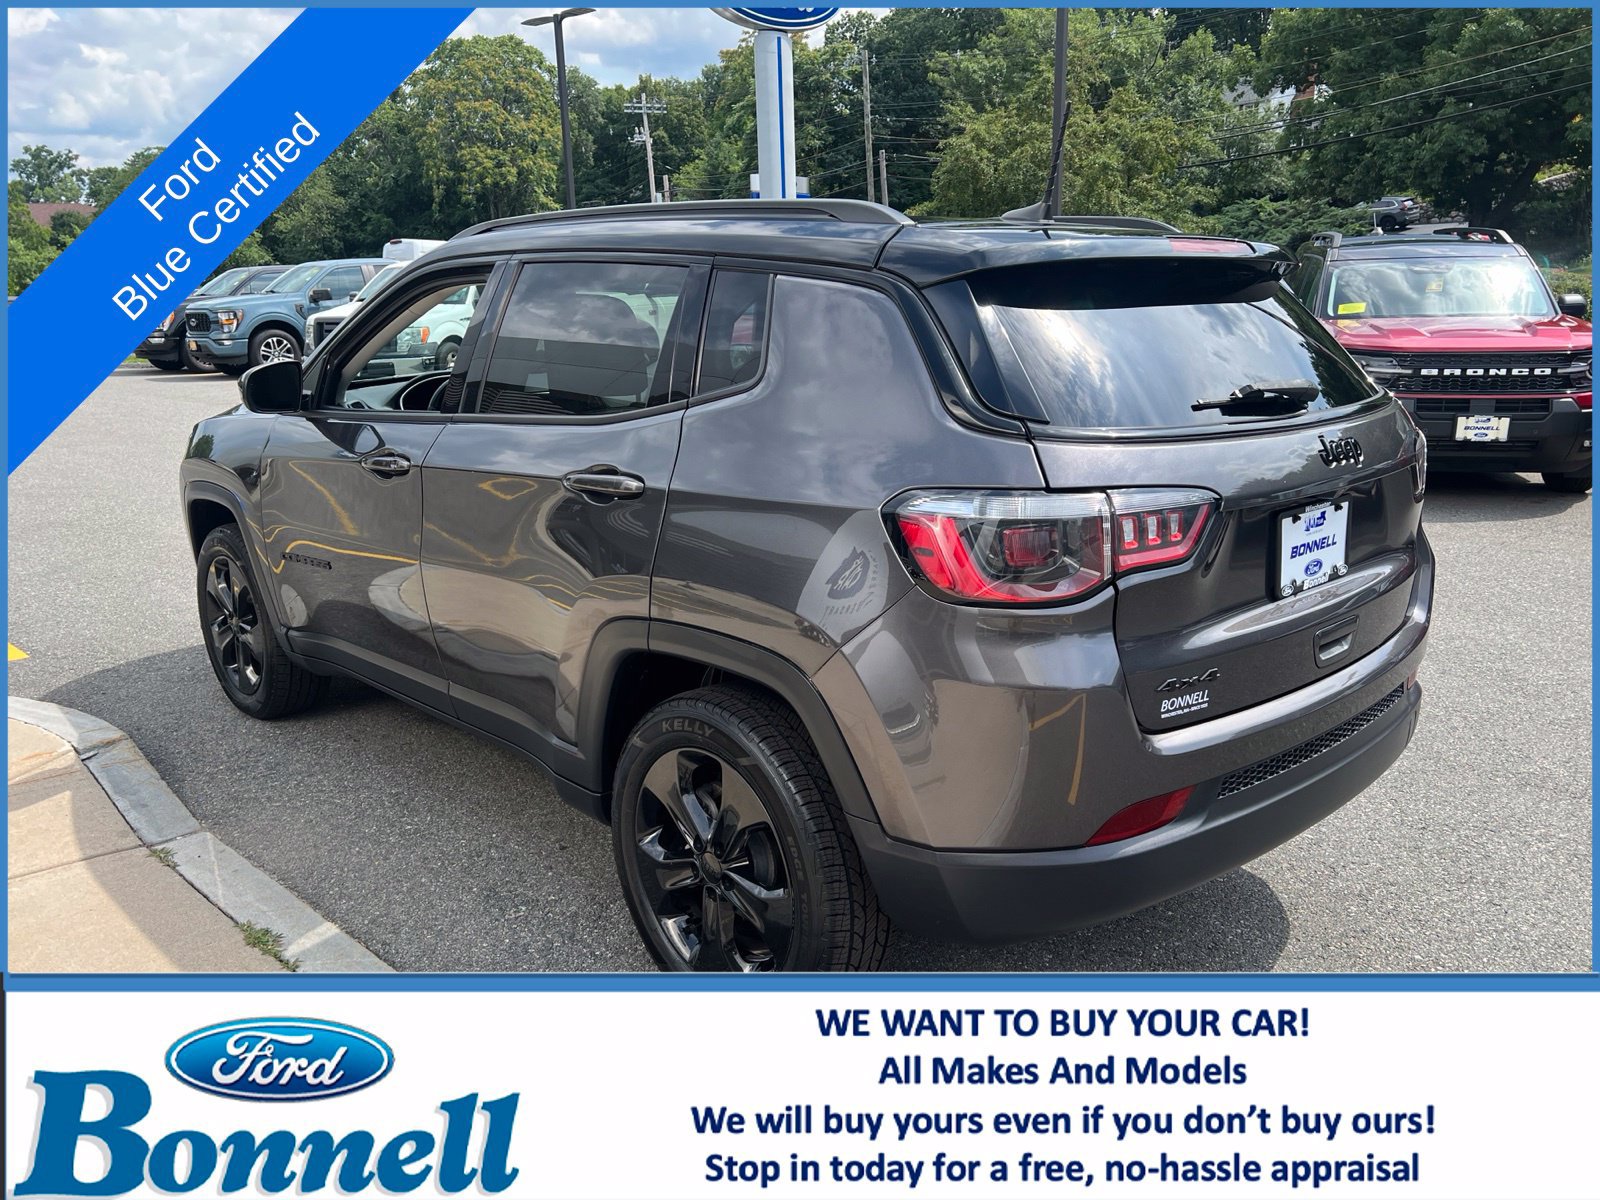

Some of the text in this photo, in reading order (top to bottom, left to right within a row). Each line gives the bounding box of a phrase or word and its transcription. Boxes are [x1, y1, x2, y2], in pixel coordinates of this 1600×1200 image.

[1420, 367, 1552, 376] BRONCO
[1317, 434, 1364, 468] Jeep
[1290, 533, 1337, 560] BONNELL
[1160, 689, 1210, 712] BONNELL
[662, 718, 716, 737] KELLY
